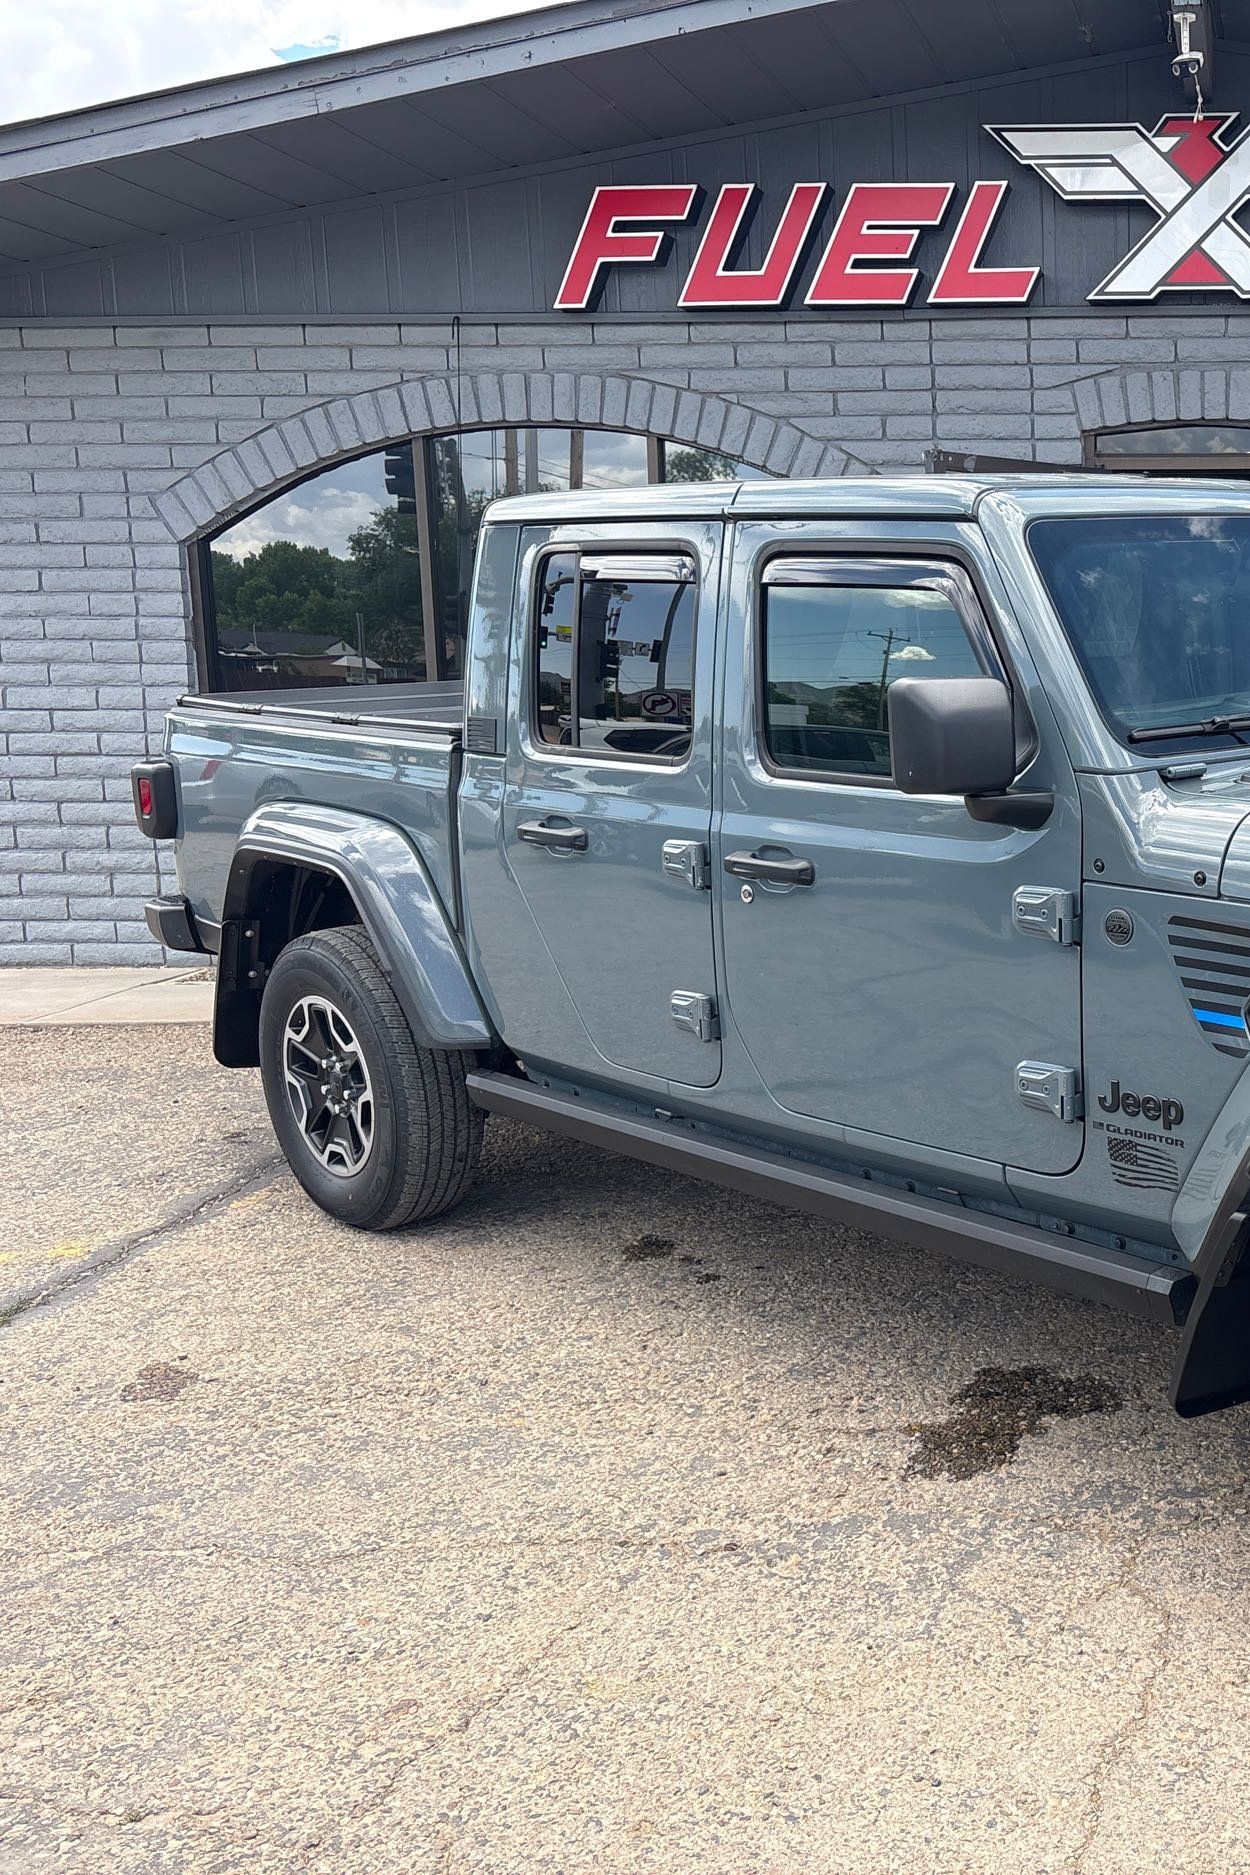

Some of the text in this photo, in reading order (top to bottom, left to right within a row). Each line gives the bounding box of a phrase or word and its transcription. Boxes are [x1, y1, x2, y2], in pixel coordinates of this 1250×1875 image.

[553, 181, 1041, 310] FUEL
[1097, 1079, 1185, 1131] Jeep
[1105, 1123, 1186, 1149] GLADIATOR
